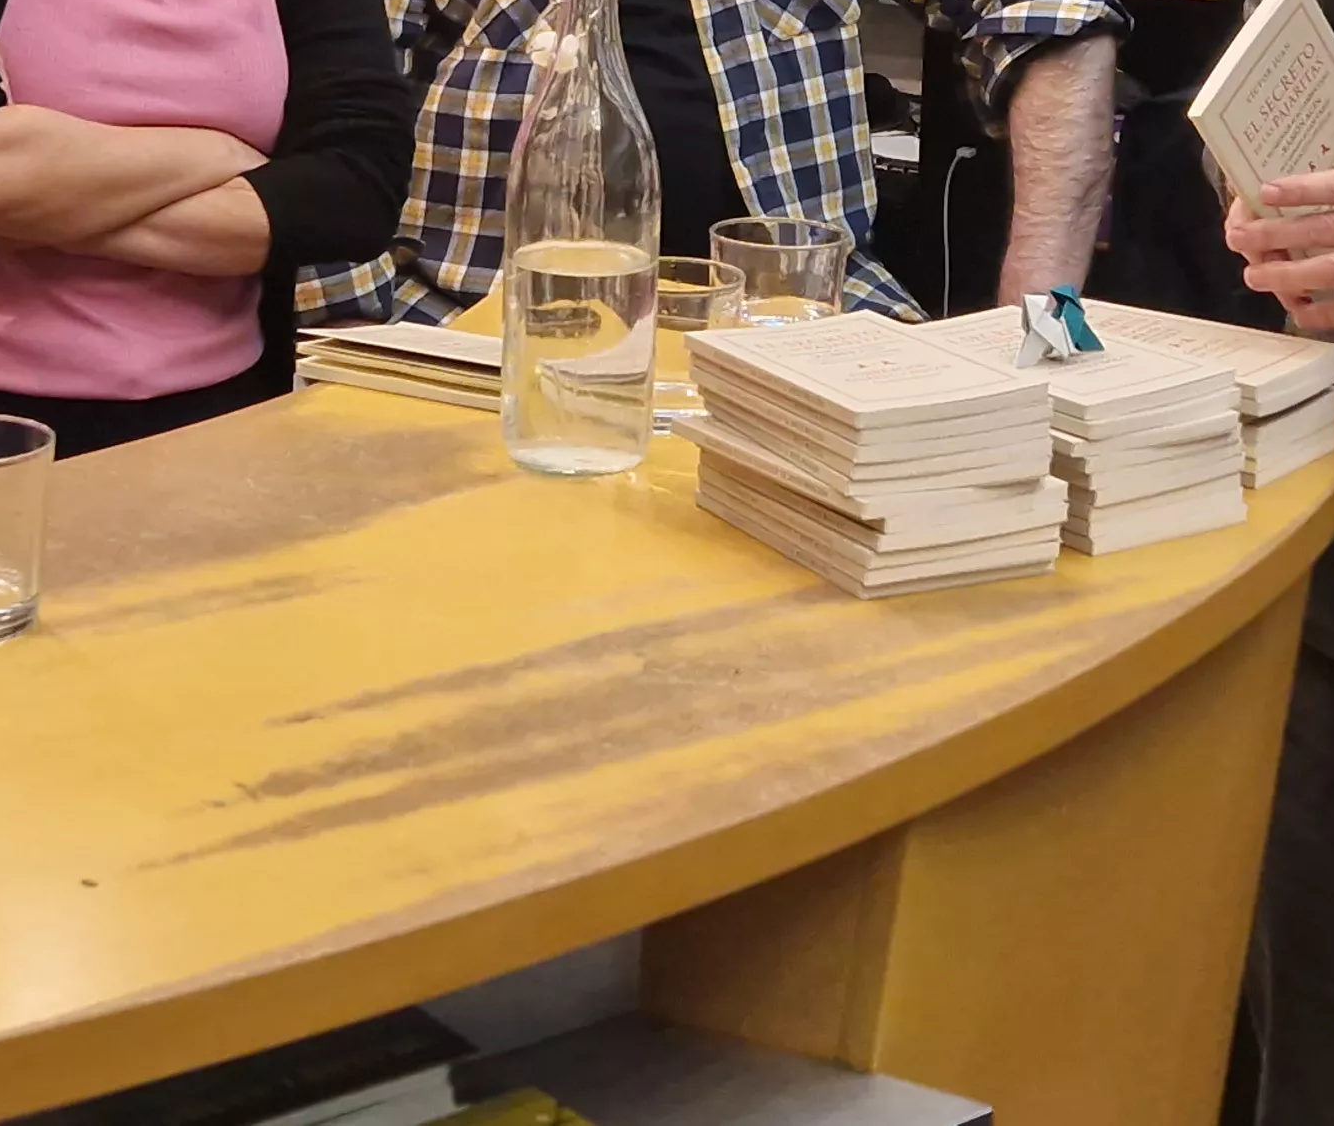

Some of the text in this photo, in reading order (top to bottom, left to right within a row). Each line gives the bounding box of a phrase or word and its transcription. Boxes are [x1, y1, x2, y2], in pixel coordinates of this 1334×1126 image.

[1243, 42, 1315, 144] EL SECRETO
[1272, 58, 1324, 128] PAJARITAS
